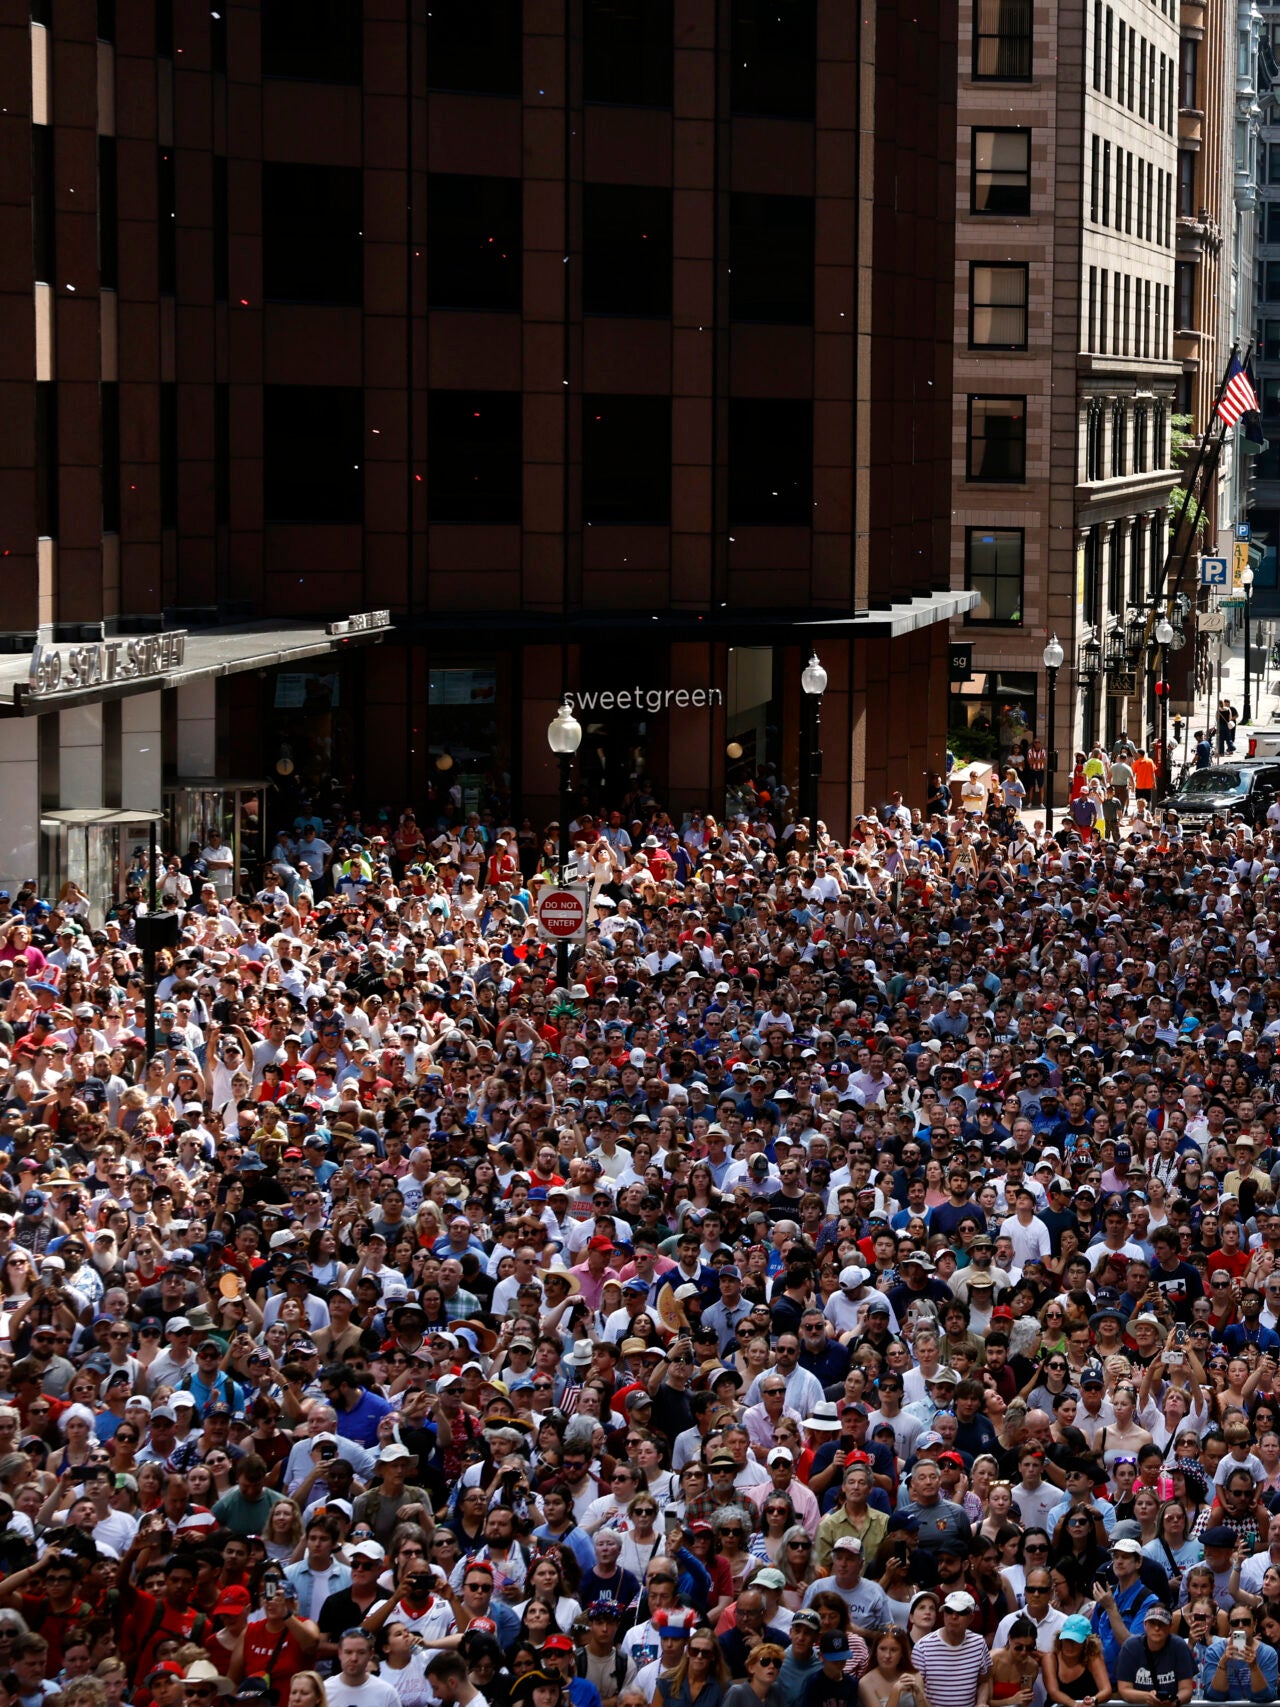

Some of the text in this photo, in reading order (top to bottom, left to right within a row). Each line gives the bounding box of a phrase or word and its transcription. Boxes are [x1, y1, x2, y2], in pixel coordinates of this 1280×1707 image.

[1204, 561, 1223, 582] P
[29, 629, 188, 693] 60 STATE STREET
[953, 657, 967, 668] sg
[563, 686, 722, 713] sweetgreen
[545, 901, 578, 909] DO NOT
[548, 919, 575, 927] ENTER
